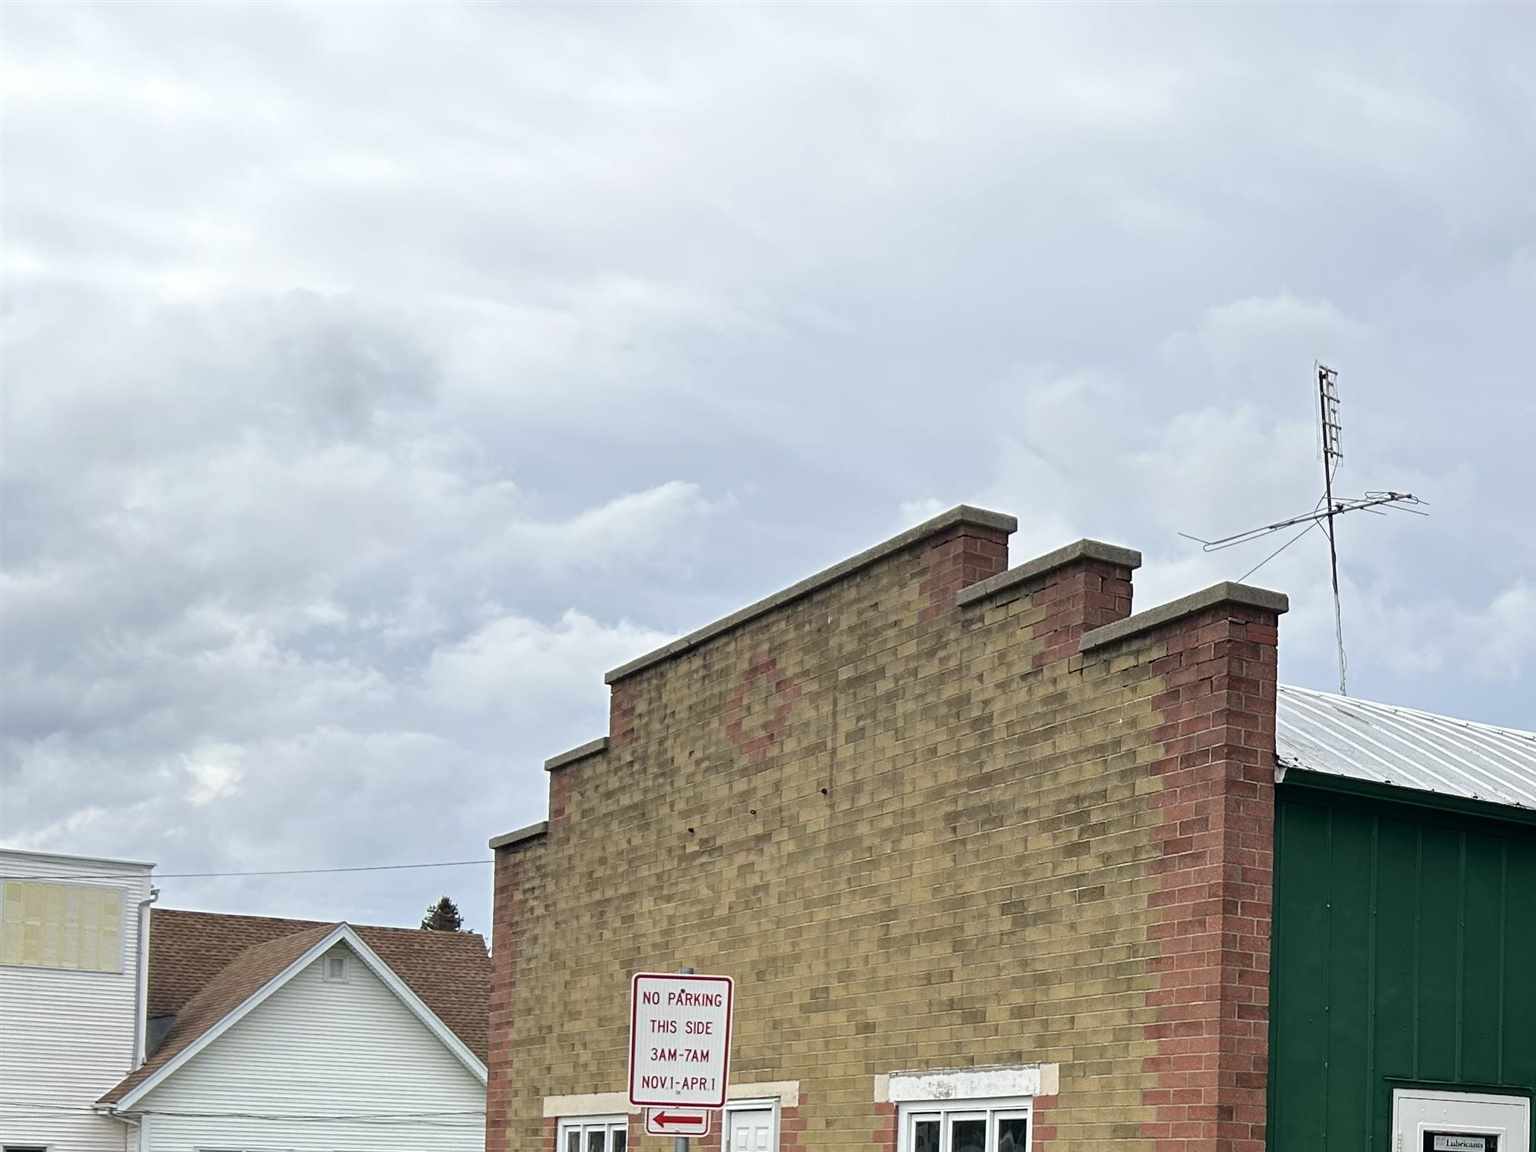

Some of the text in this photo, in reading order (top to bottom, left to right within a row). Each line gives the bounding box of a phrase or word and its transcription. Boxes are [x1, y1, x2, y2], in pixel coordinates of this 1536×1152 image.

[643, 991, 722, 1007] NO PARKING
[650, 1019, 713, 1035] THIS SIDE
[650, 1047, 710, 1063] 3AM-7AM
